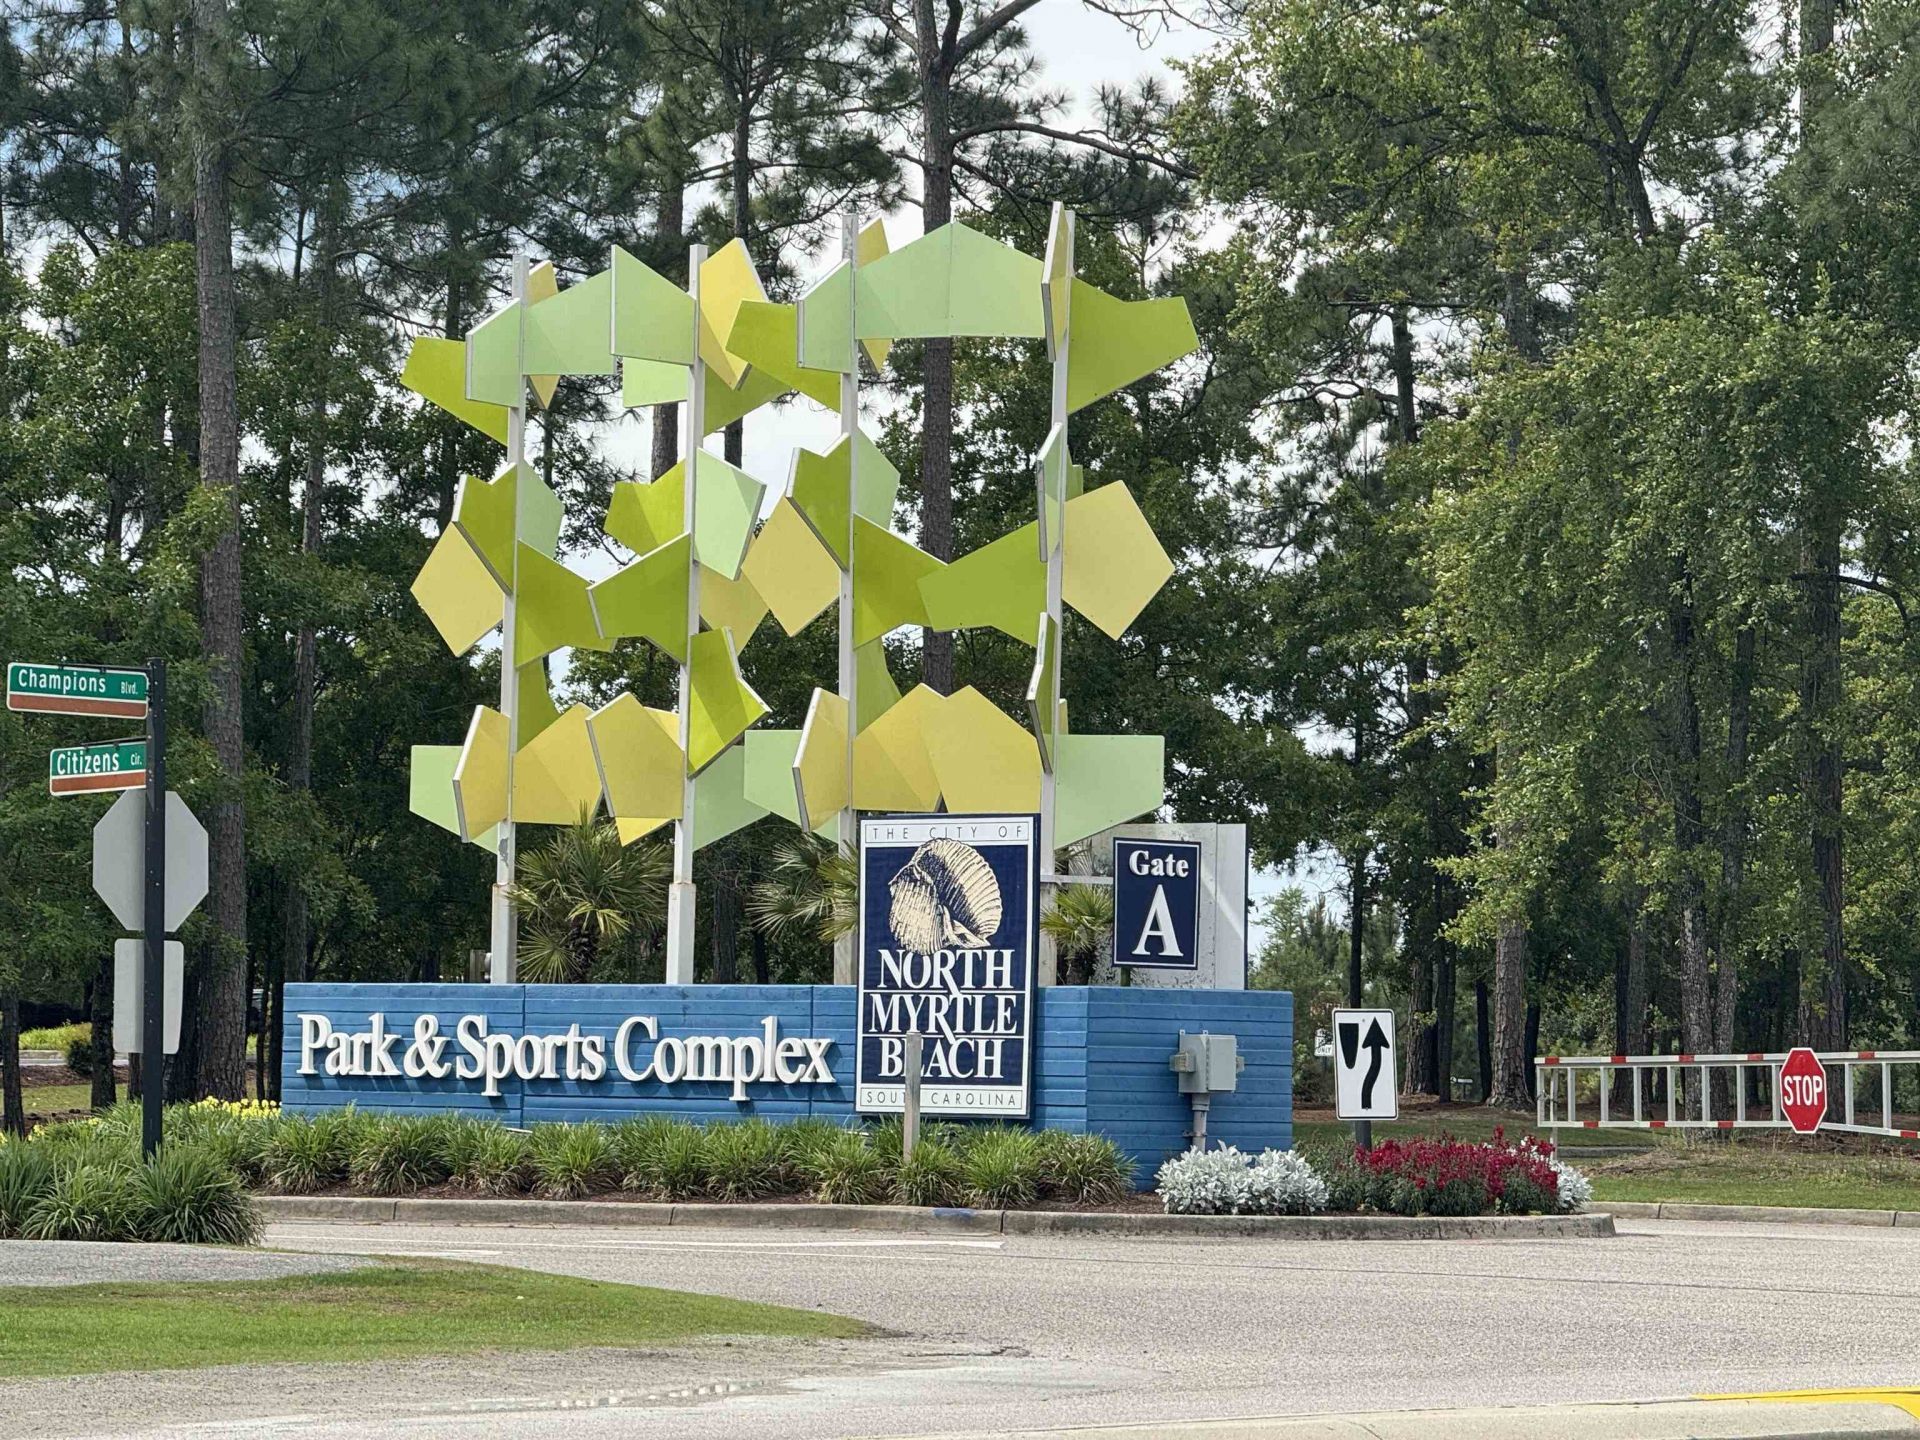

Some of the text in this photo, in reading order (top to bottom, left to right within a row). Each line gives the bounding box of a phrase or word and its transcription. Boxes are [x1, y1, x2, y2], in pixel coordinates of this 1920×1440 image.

[18, 668, 139, 695] Champions Blvd.
[56, 750, 143, 775] Citizens Cir.
[872, 825, 1022, 840] THE CITY OF
[1128, 849, 1189, 878] Gate
[1131, 883, 1184, 957] A
[877, 949, 1015, 993] NORTH
[868, 993, 1018, 1037] MYRTLE
[296, 1012, 837, 1101] Park & Sports Complex
[866, 1090, 1017, 1107] SOU CAROLINA
[1784, 1075, 1823, 1106] STOP
